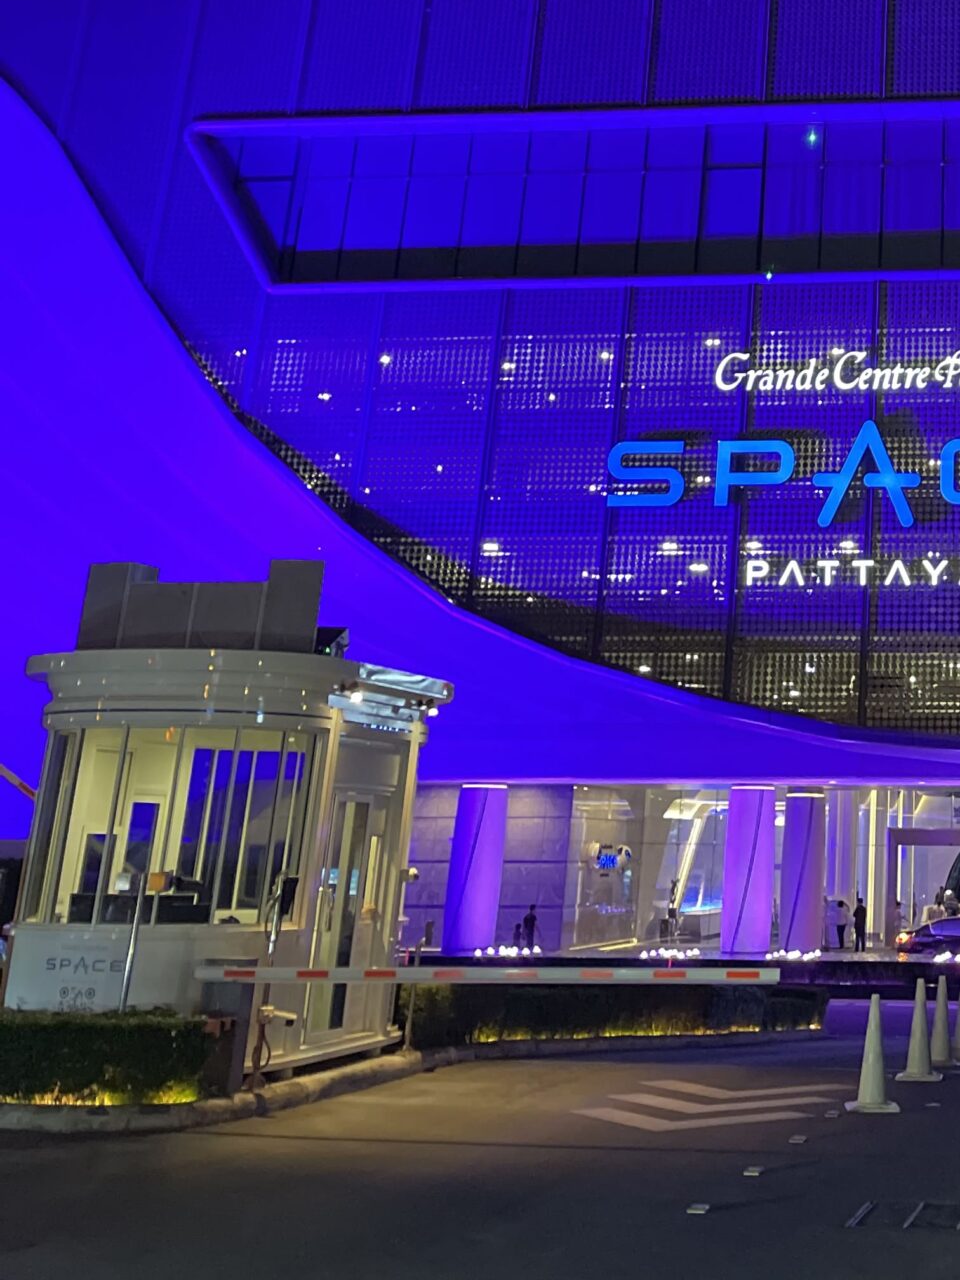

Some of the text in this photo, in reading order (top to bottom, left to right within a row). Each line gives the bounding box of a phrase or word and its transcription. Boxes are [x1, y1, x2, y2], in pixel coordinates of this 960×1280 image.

[715, 352, 828, 391] Grande
[833, 351, 930, 390] Centre
[46, 955, 124, 975] SPACE
